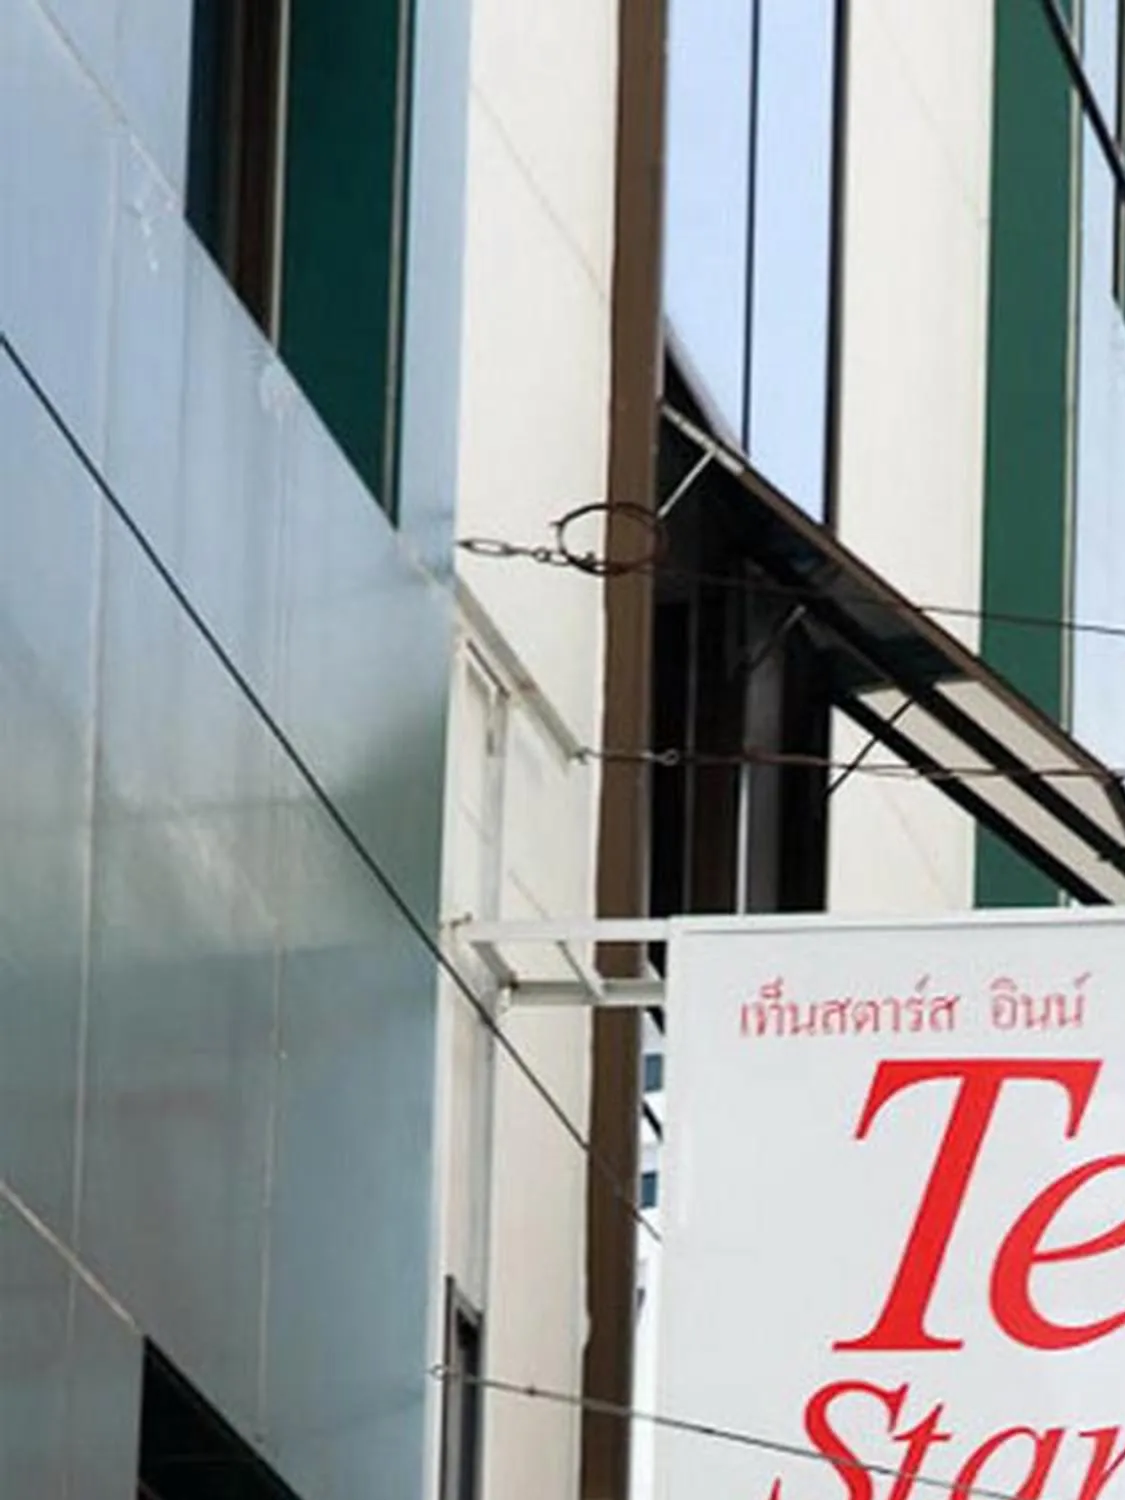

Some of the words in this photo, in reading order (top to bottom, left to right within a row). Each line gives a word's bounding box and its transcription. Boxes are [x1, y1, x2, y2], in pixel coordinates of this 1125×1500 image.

[739, 976, 960, 1037] เท็นสตาร์ส
[989, 972, 1091, 1031] อินน์
